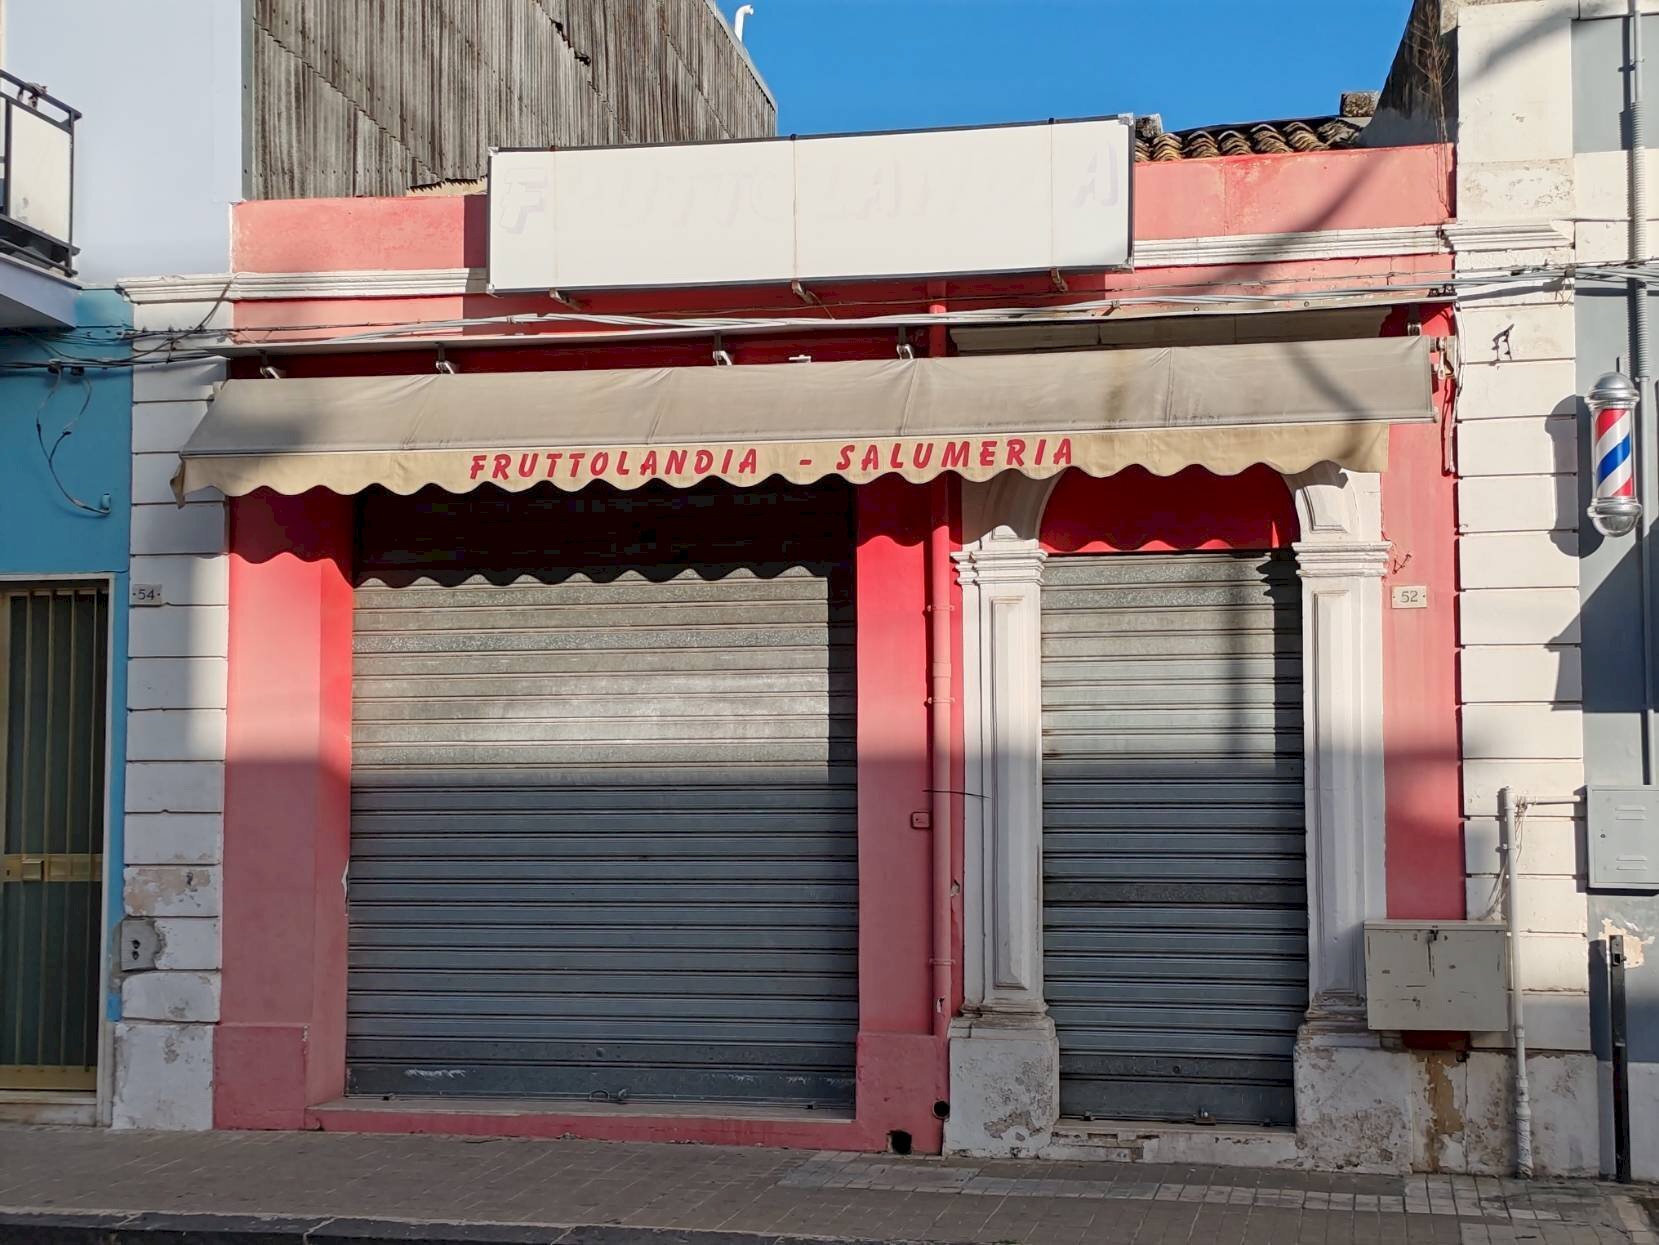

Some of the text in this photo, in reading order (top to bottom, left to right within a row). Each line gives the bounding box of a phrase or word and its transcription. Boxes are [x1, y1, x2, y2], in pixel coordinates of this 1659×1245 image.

[470, 449, 757, 480] FRUTTOLANDIA
[836, 438, 1073, 471] SALUMERIA
[138, 588, 155, 600] 54
[1400, 590, 1418, 603] 52
